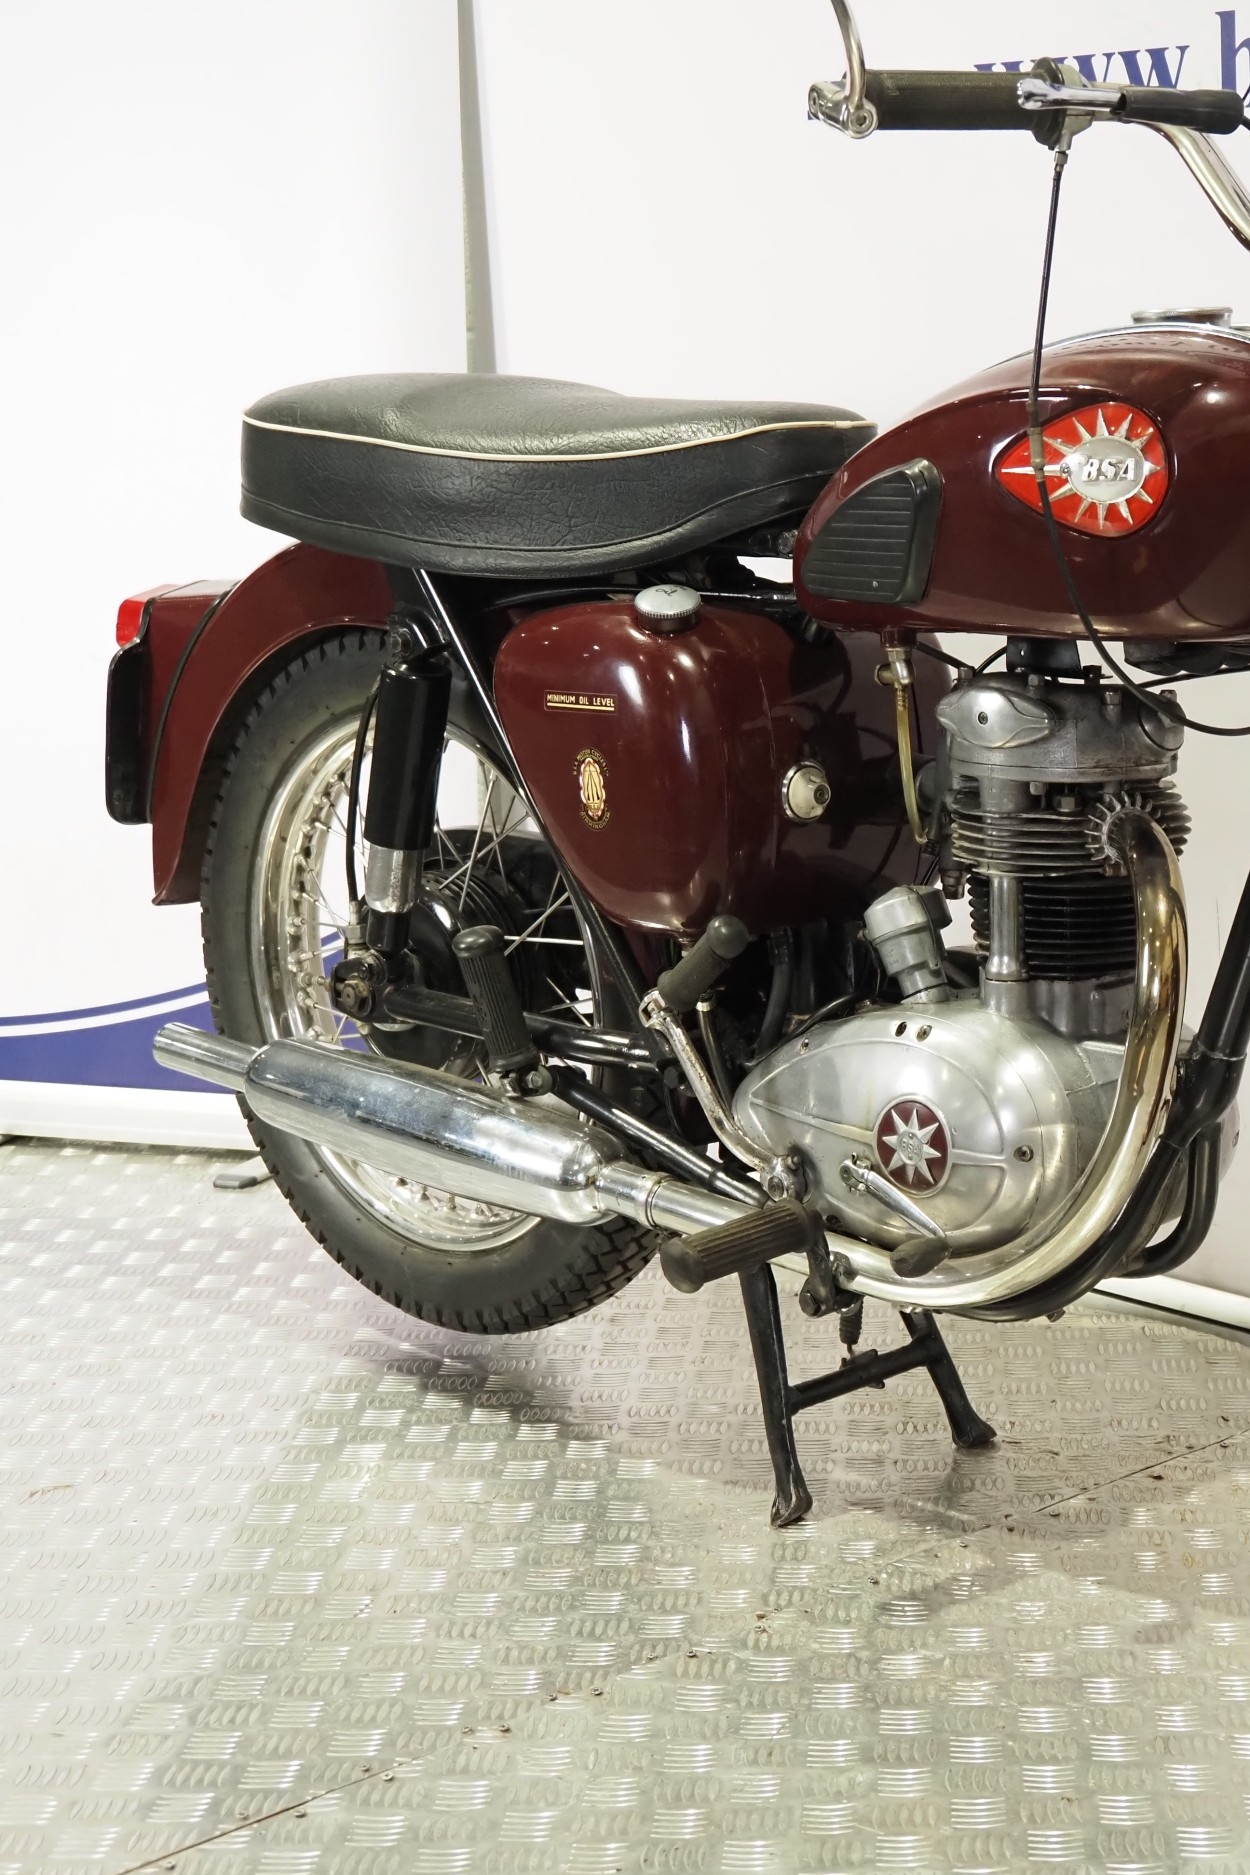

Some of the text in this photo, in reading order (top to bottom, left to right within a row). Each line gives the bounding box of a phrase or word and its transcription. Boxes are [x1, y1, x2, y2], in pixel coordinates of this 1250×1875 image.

[1079, 455, 1137, 482] BSA
[547, 694, 615, 707] MINIMUM OIL LEVEL
